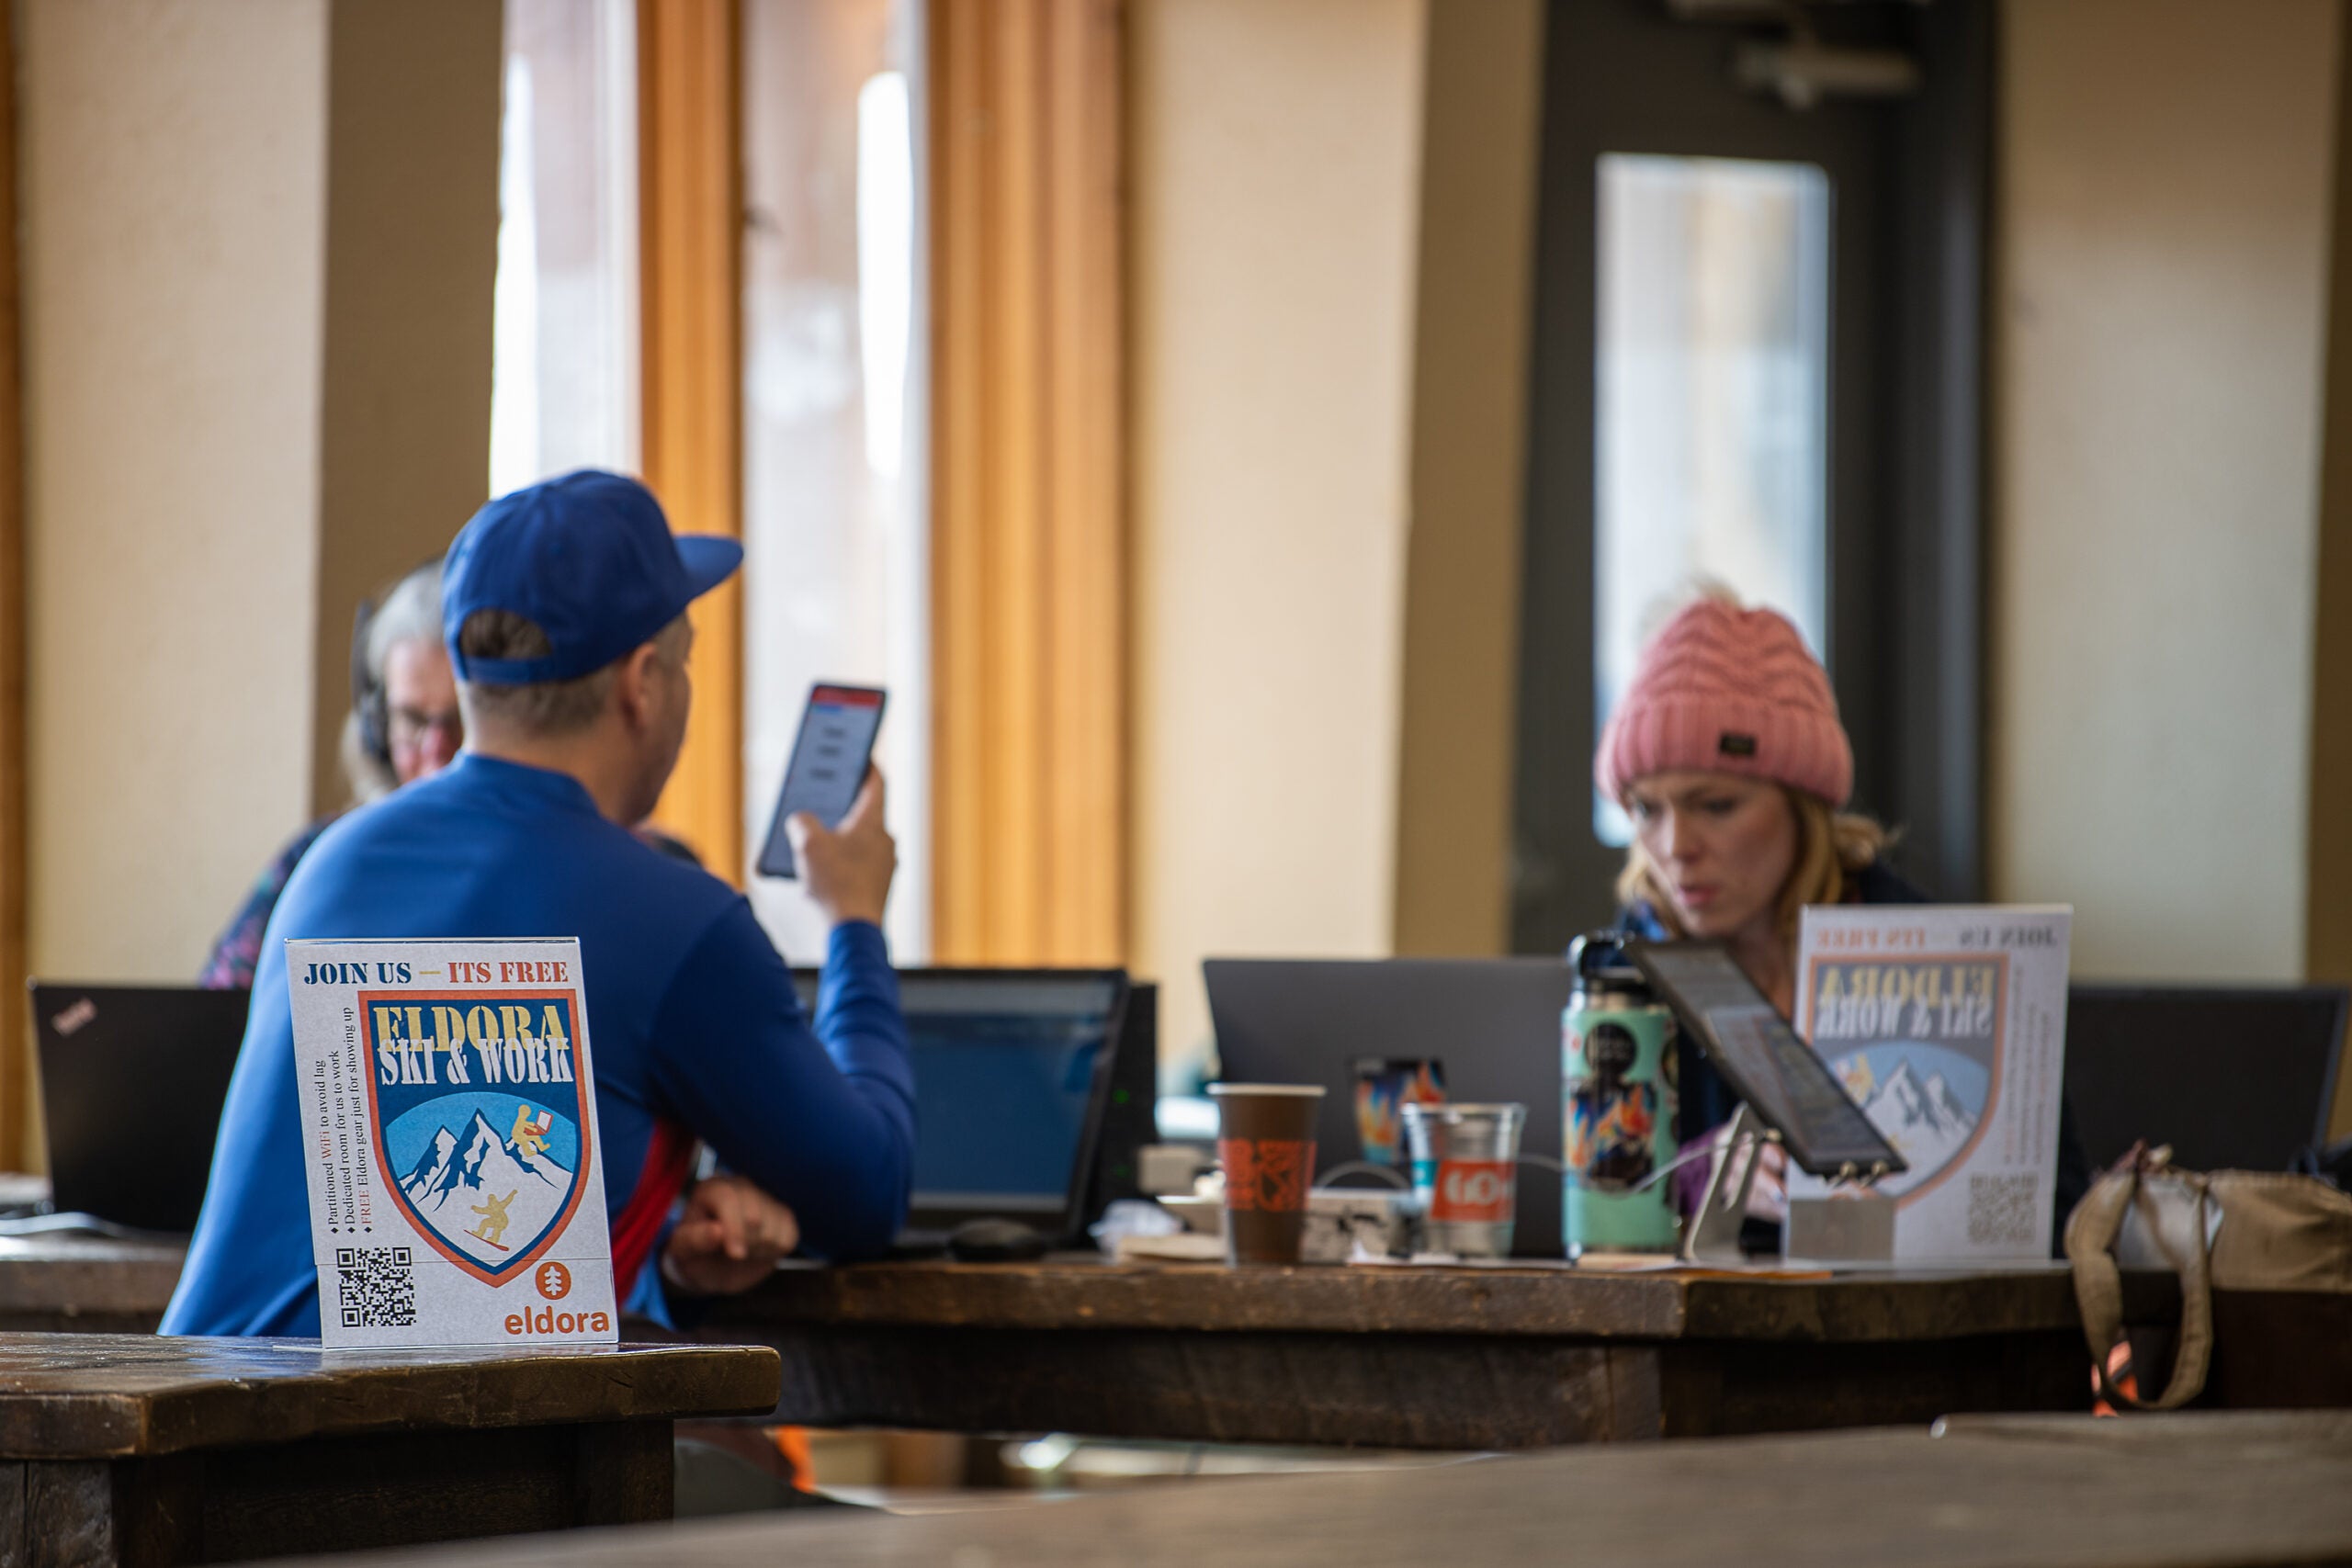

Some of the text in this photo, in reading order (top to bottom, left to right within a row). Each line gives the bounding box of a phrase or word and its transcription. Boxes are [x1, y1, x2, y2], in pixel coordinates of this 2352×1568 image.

[304, 963, 368, 985] JOIN
[376, 962, 412, 984] US
[447, 961, 492, 983] ITS
[499, 961, 569, 983] FREE
[373, 1006, 570, 1052] ELDORA
[379, 1037, 573, 1085] SKI & WORK
[328, 1050, 356, 1224] Dedicated room for us to work
[343, 1007, 372, 1224] FREE Eldora gear just for showing up
[313, 1060, 339, 1224] Partitioned WiFi to avoid lag
[503, 1305, 610, 1336] eldora
